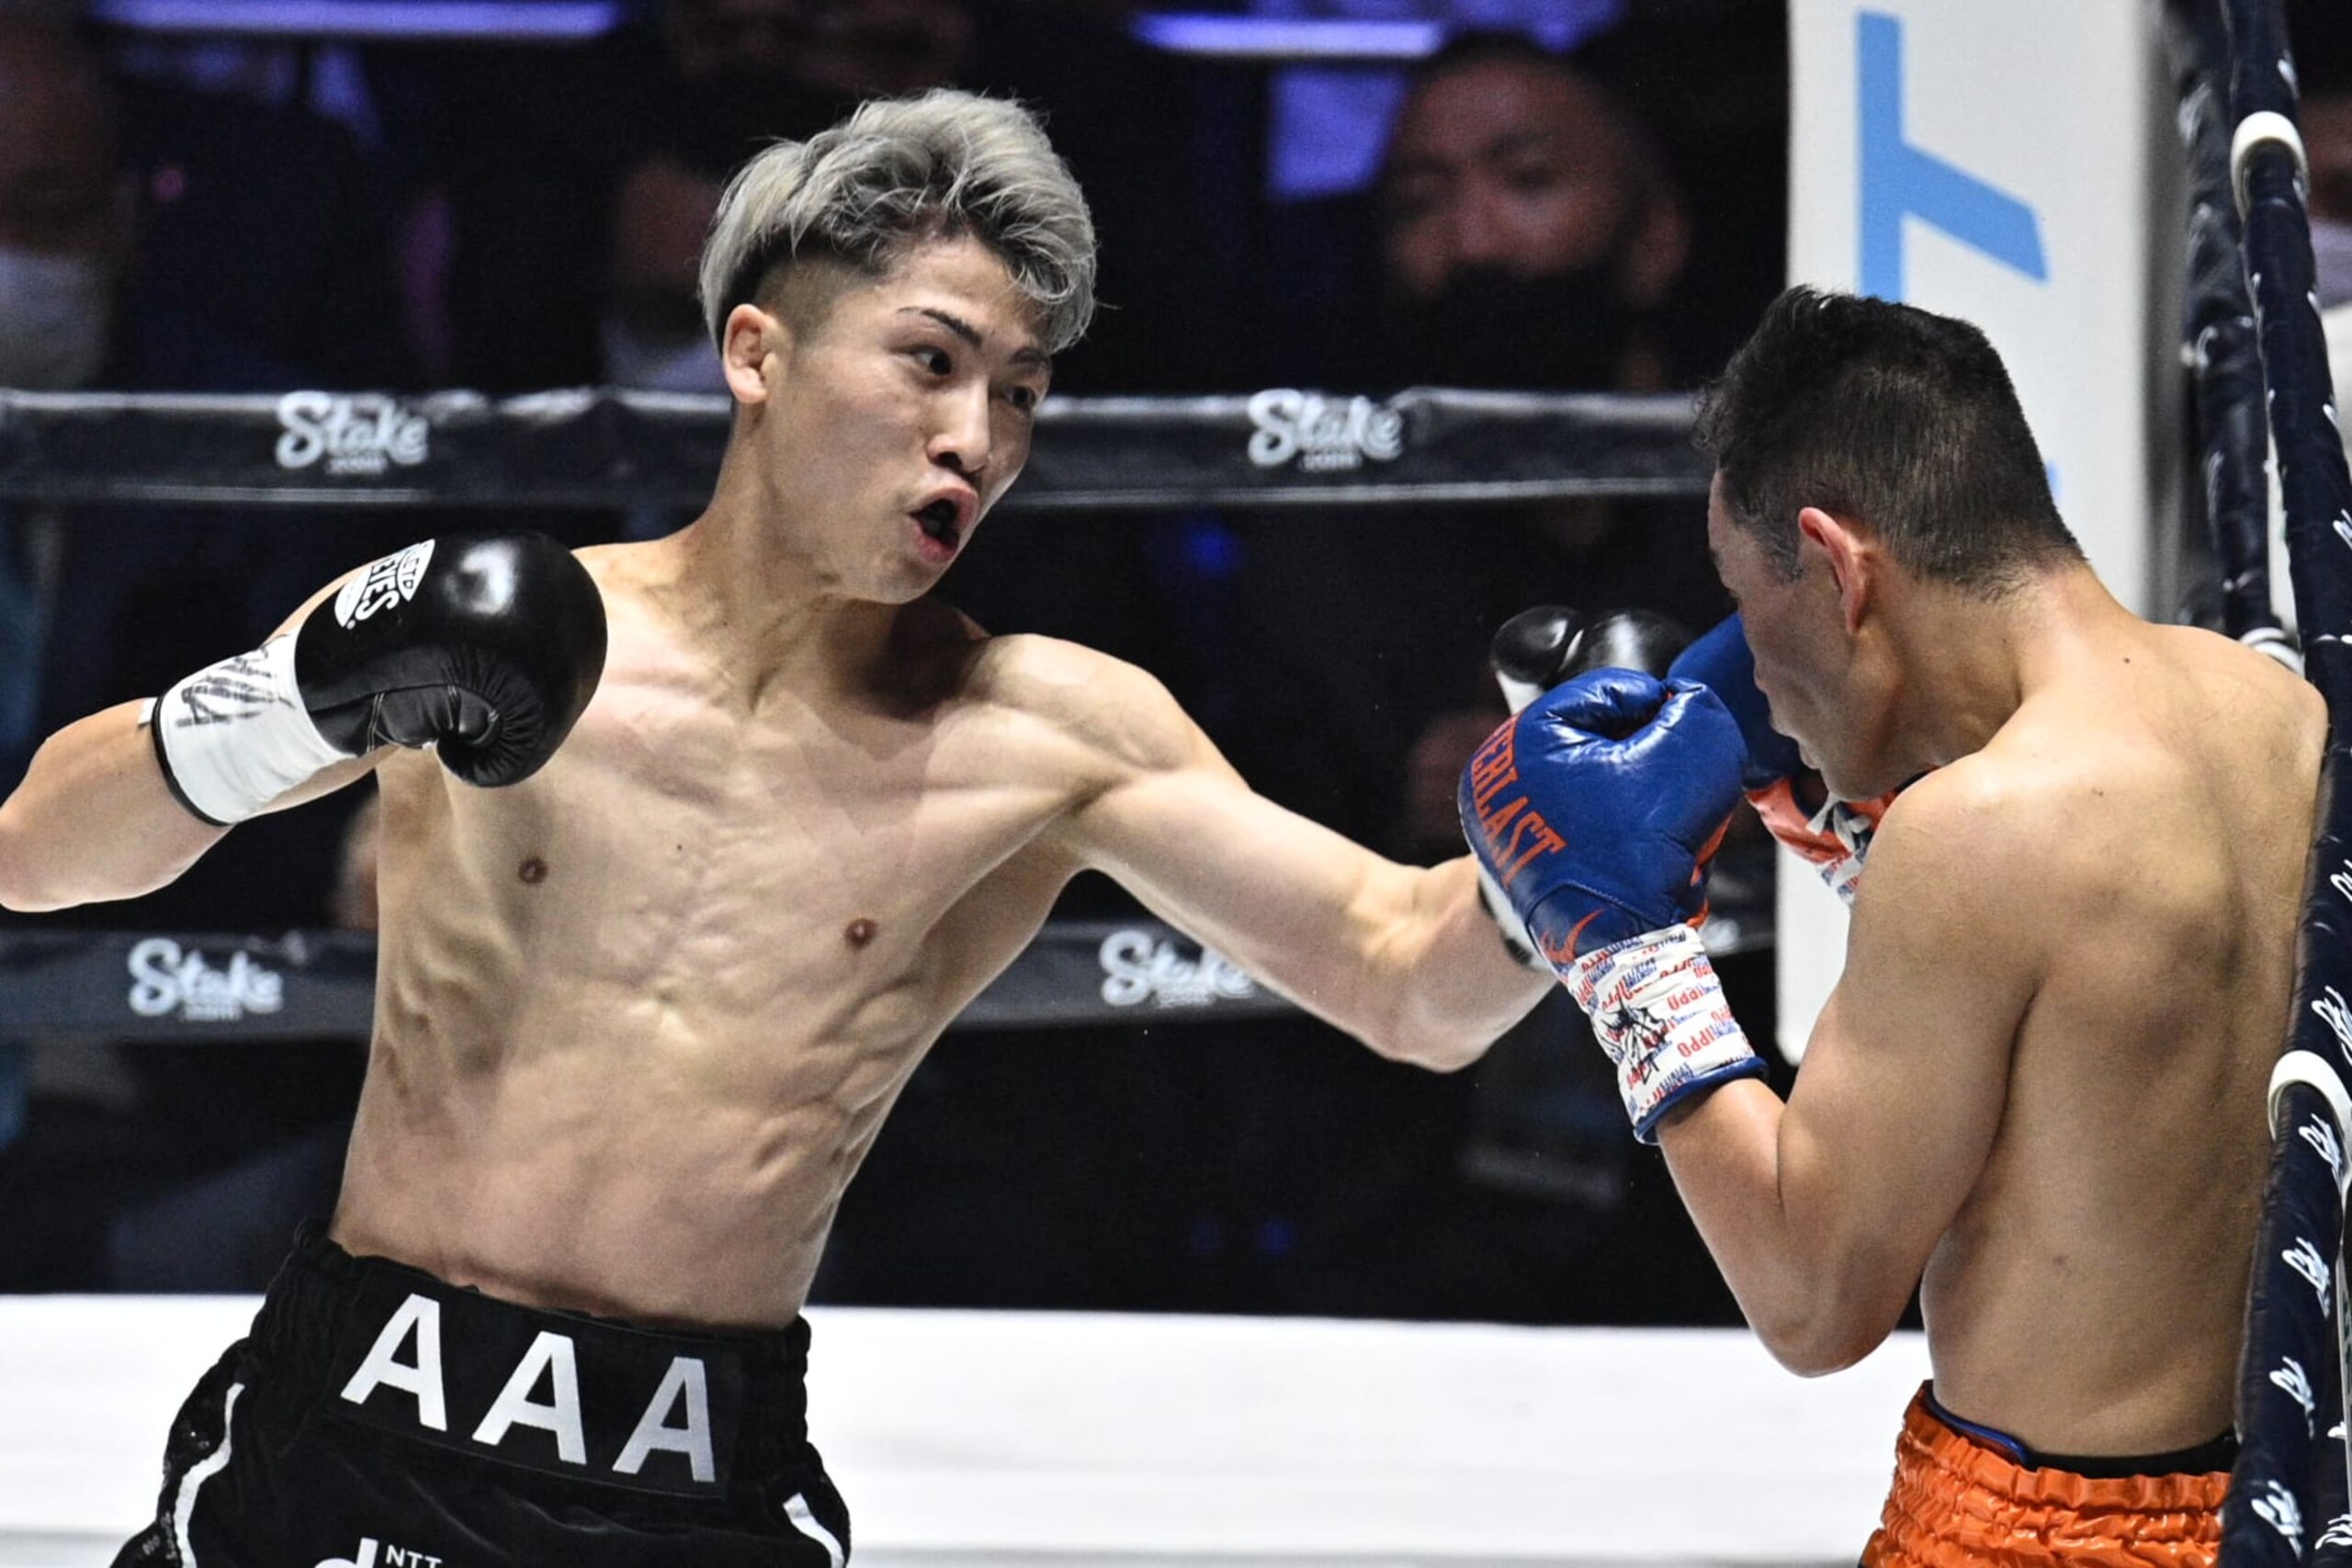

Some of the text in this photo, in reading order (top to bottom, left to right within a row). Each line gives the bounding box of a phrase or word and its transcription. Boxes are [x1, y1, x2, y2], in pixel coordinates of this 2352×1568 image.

[277, 389, 429, 468] Stake
[1248, 389, 1403, 466] Stake
[129, 938, 284, 1017] Stake
[1677, 1026, 1716, 1058] IPPO
[386, 1544, 442, 1568] NTT
